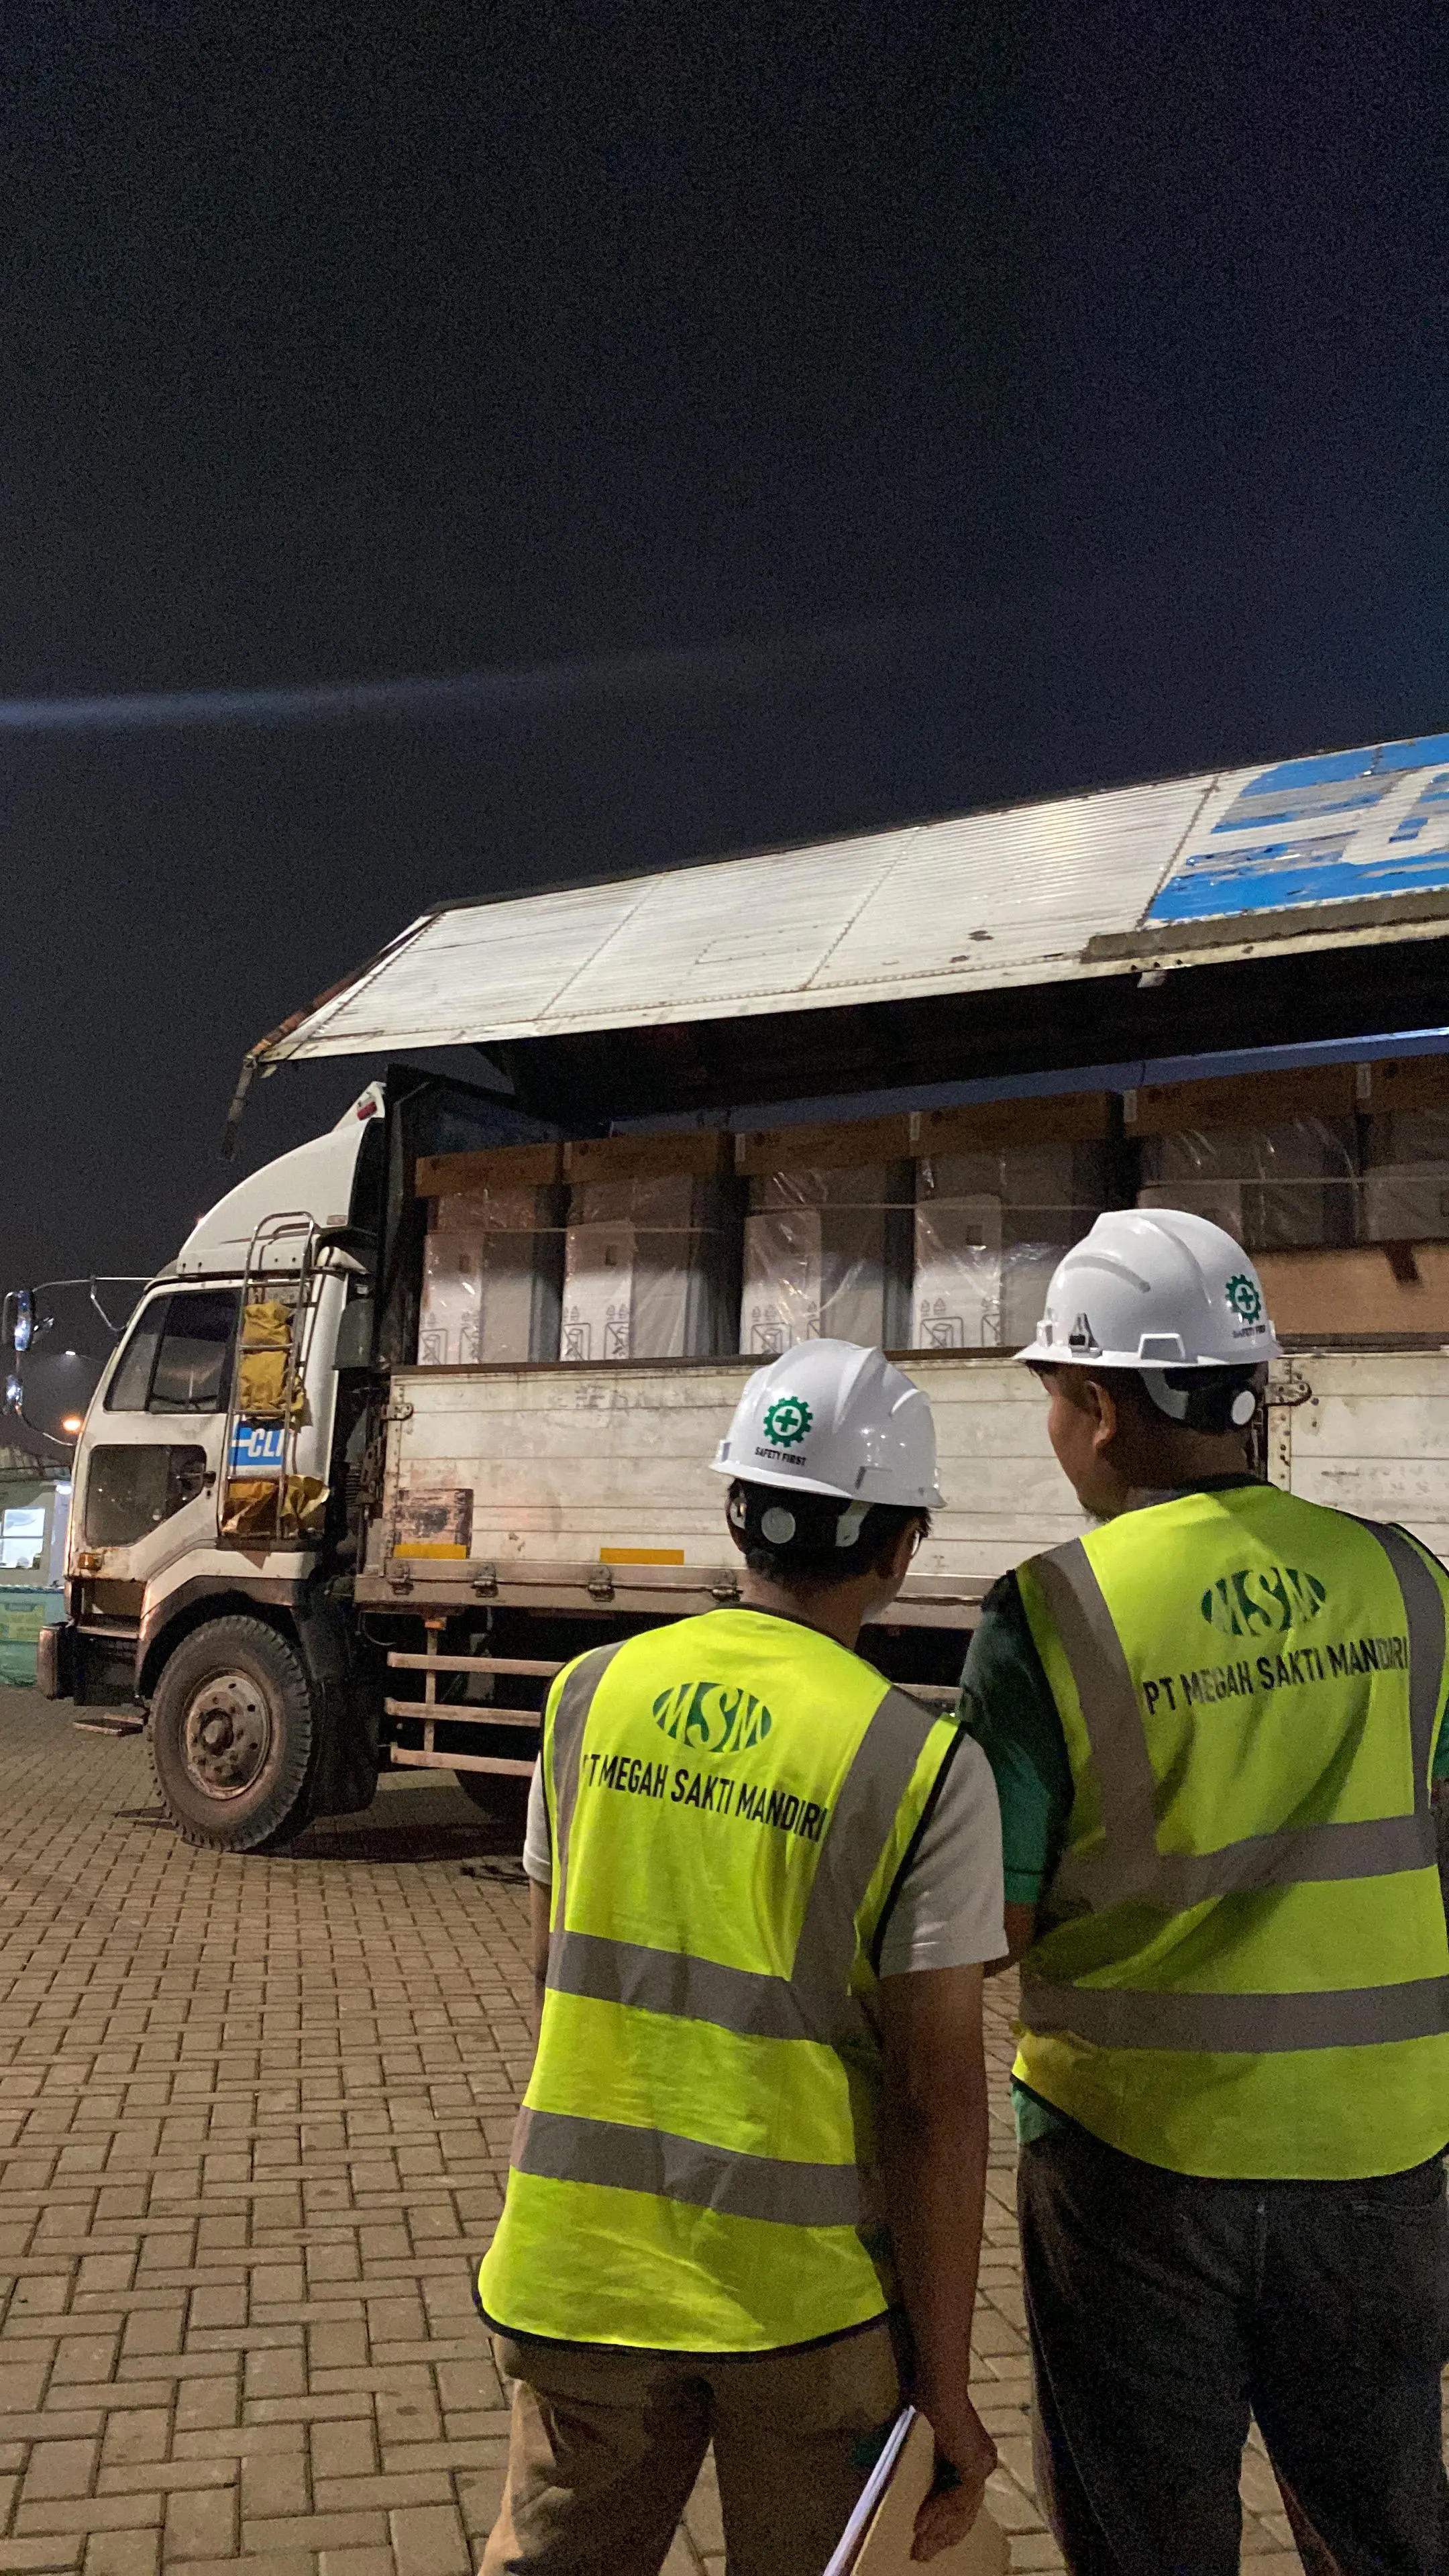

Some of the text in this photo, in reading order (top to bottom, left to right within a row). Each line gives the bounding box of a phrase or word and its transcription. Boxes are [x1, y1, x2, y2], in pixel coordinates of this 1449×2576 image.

[755, 1447, 807, 1466] SAFETY FIRST
[1142, 1677, 1175, 1715] PT
[1179, 1660, 1253, 1705] MEGAH
[1256, 1647, 1324, 1690] SAKTI
[652, 1682, 771, 1753] MSM
[598, 1754, 669, 1799] MEGAH
[671, 1768, 735, 1814] SAKTI
[736, 1782, 828, 1843] MANDIRI
